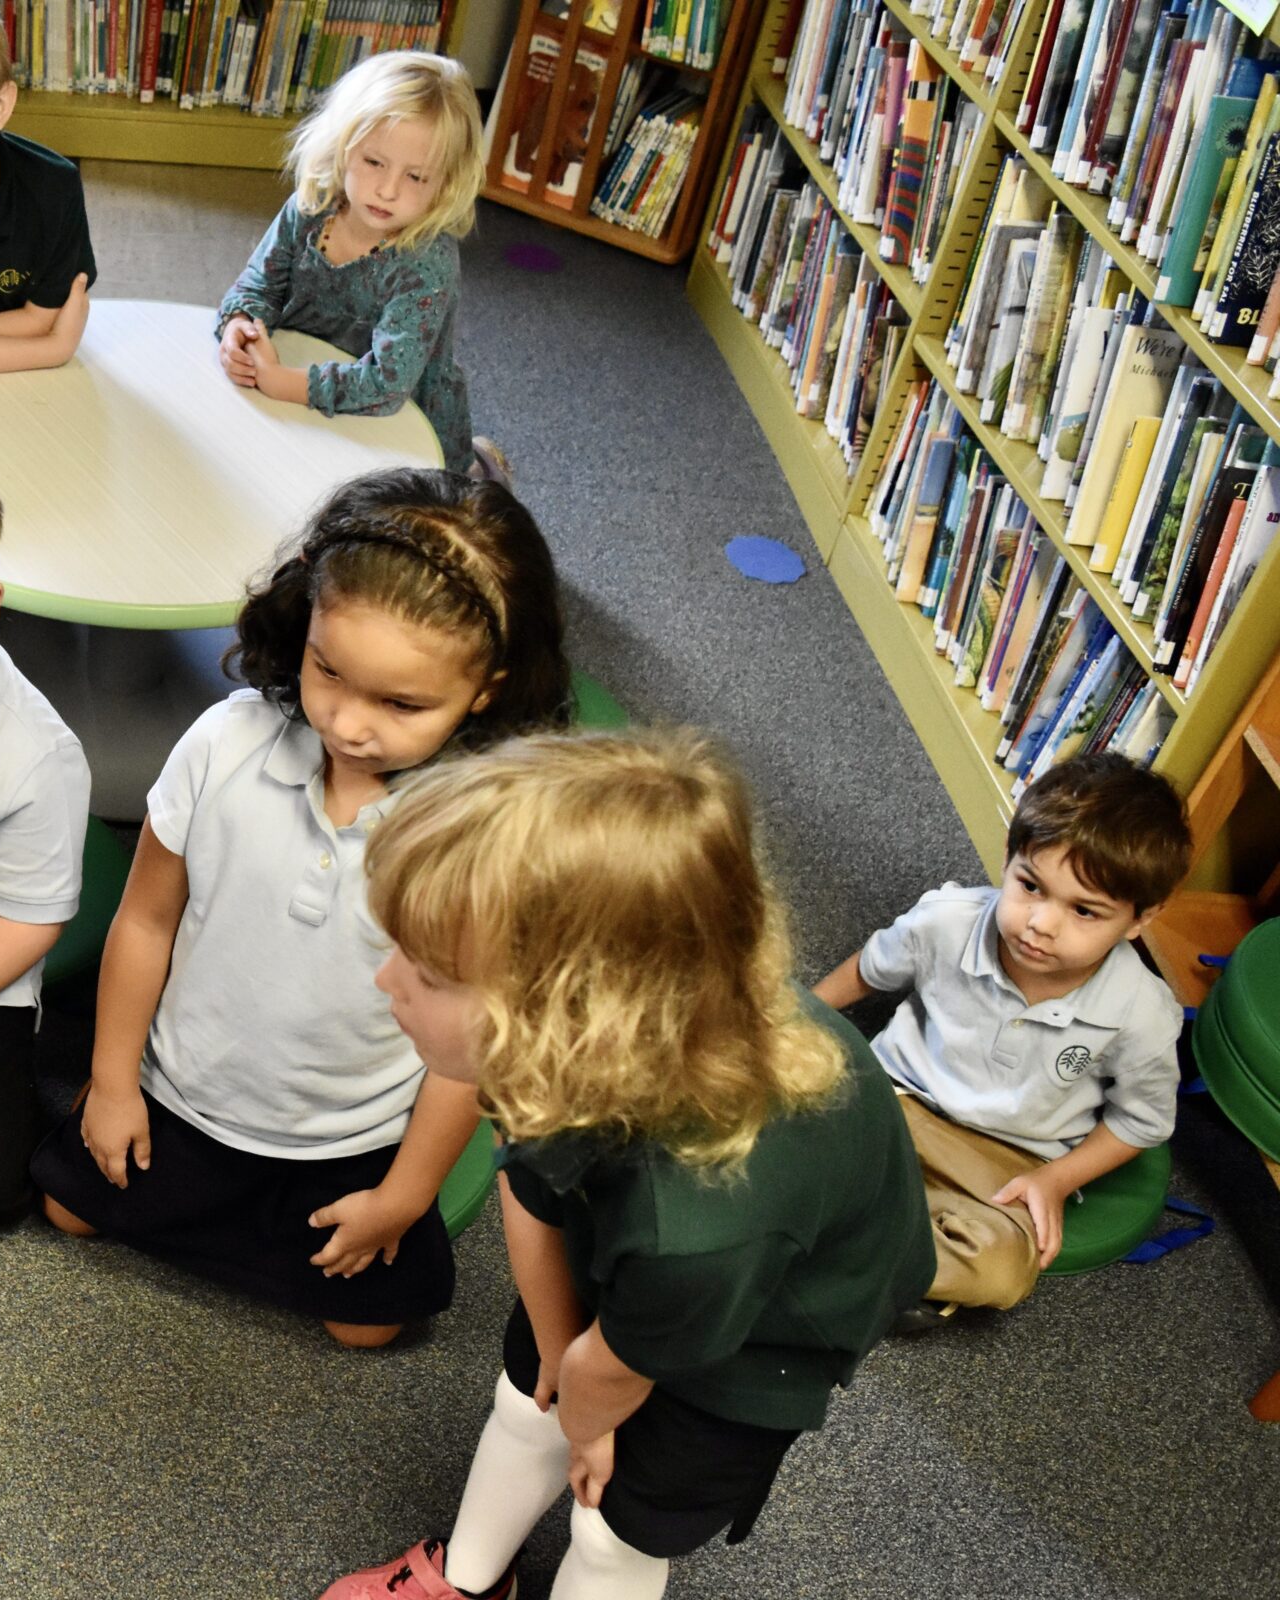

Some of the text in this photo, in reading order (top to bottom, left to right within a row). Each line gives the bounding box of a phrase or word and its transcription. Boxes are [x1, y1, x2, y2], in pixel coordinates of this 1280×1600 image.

[1219, 191, 1259, 303] BLUEBERRIES FOR SAL
[1136, 337, 1175, 357] We're
